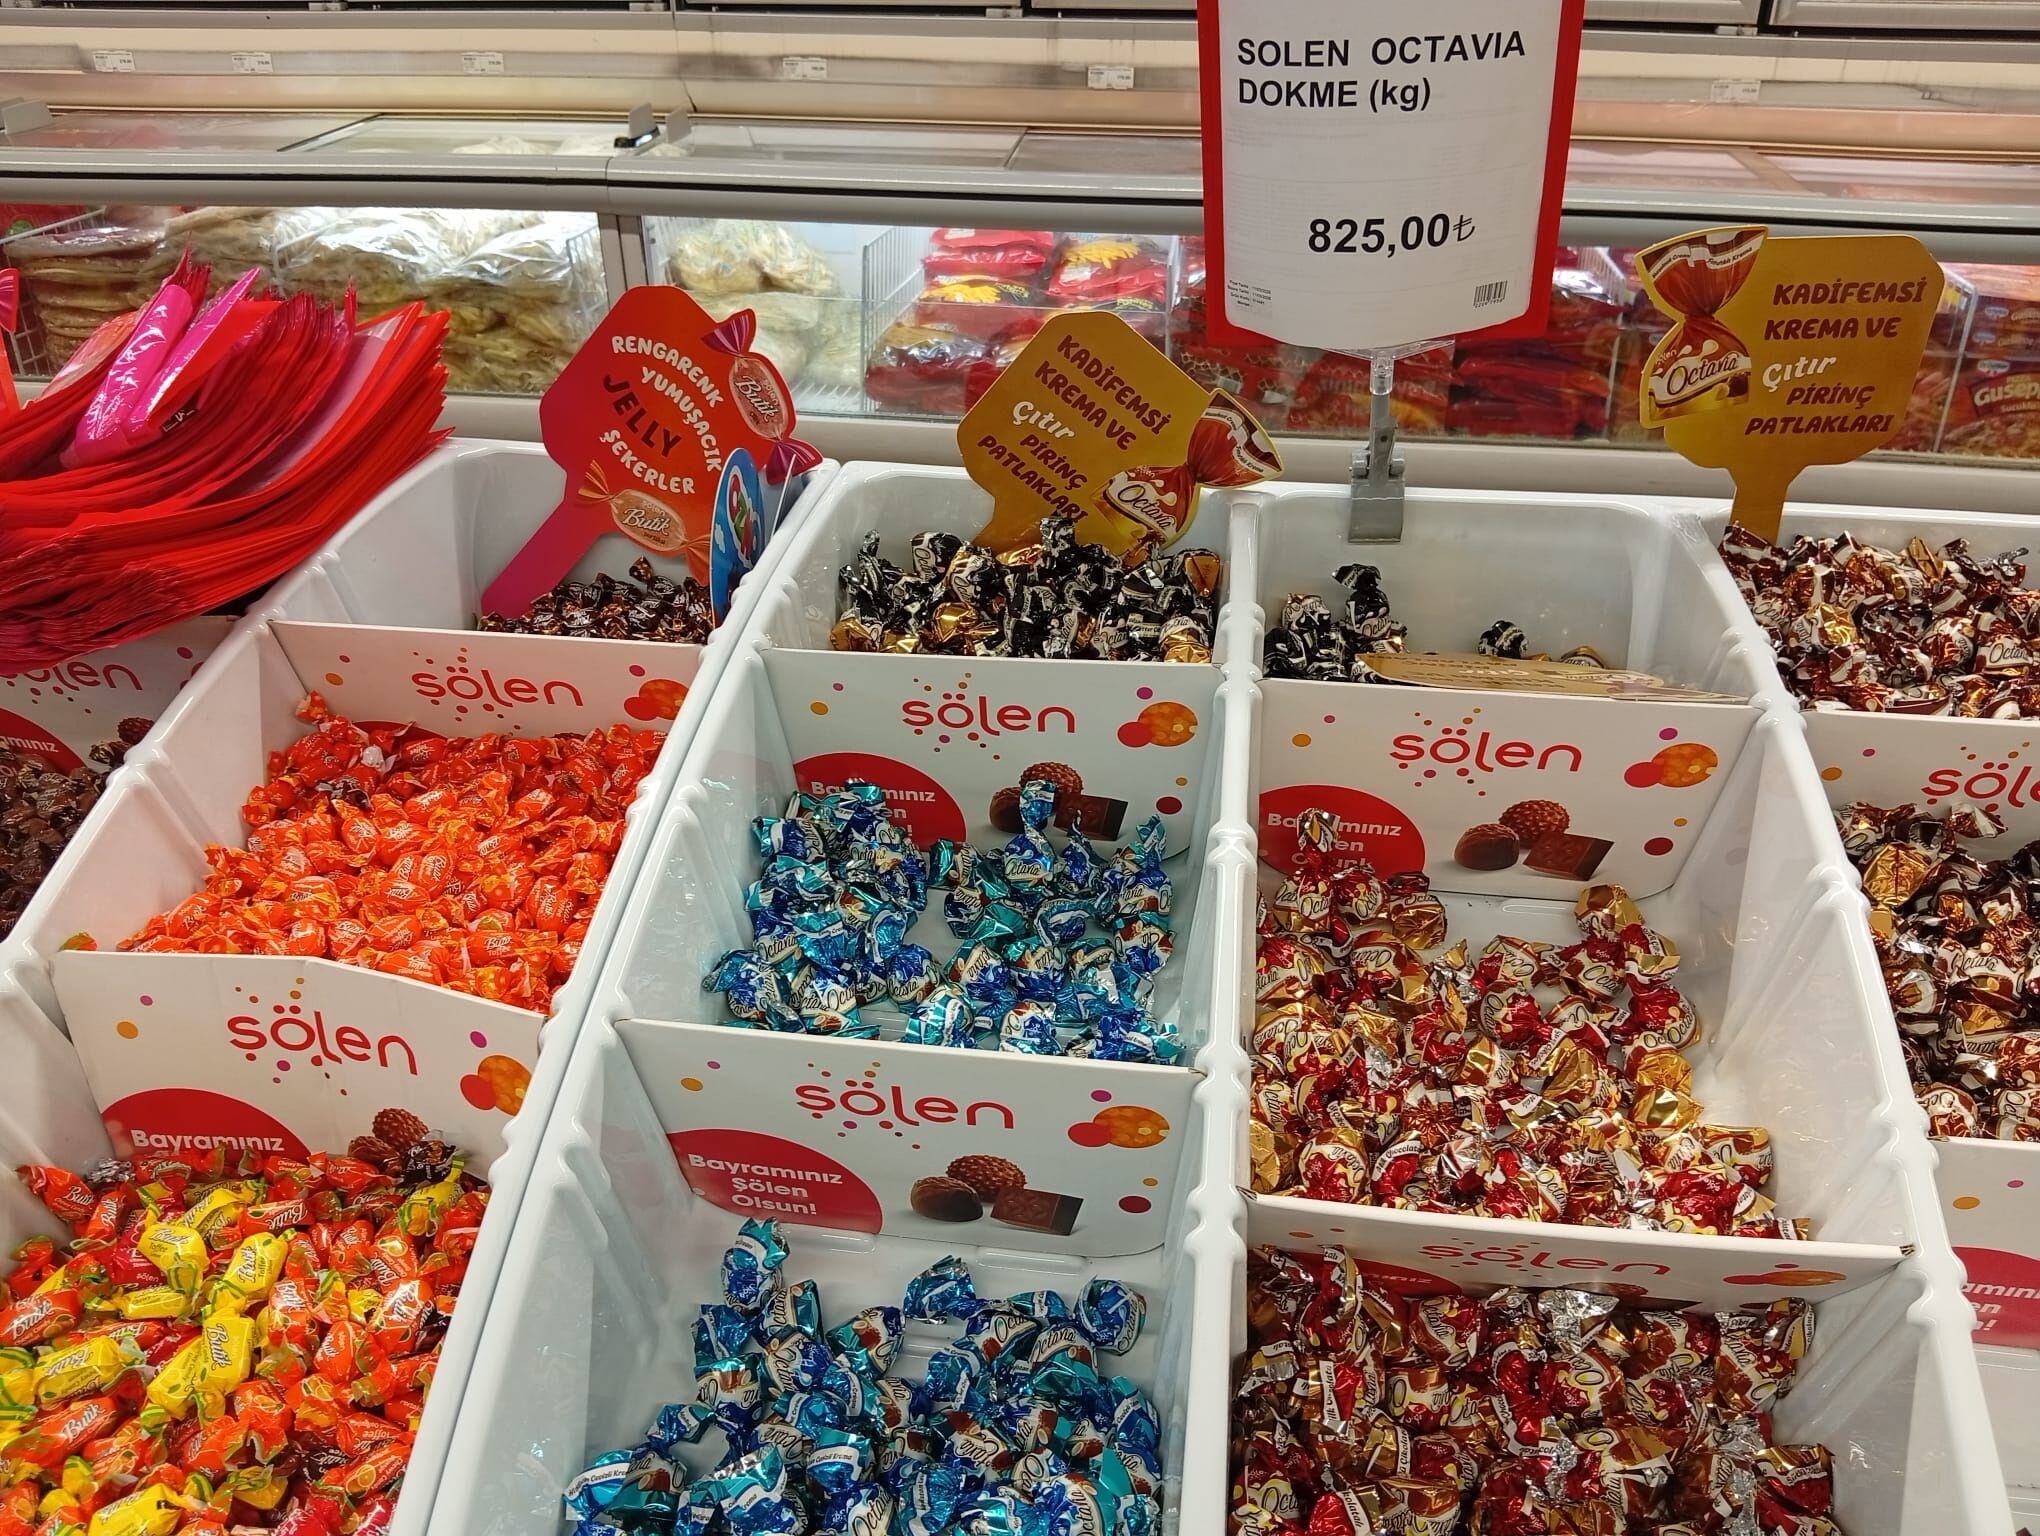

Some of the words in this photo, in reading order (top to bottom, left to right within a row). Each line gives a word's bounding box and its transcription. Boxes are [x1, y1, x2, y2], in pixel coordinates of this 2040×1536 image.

[1238, 38, 1349, 67] SOLEN
[1371, 31, 1526, 65] OCTAVIA
[1239, 79, 1358, 107] DOKME
[1370, 78, 1431, 112] (kg)
[1773, 276, 1927, 306] KADİFEMSİ
[1763, 318, 1859, 341] KREMA
[1865, 316, 1903, 338] VE
[612, 336, 725, 408] RENGARENK
[1056, 334, 1173, 435] KADİFEMSİ
[1666, 351, 1739, 397] Octavia
[1761, 354, 1838, 393] Çıtır
[603, 375, 682, 458] JELLY
[735, 375, 779, 422] Butik
[1034, 360, 1107, 429] KREMA
[1105, 418, 1137, 451] VE
[1786, 383, 1876, 410] PİRİNÇ
[641, 367, 722, 472] YUMUŞACIK
[1012, 400, 1077, 440] Çıtır
[1744, 414, 1895, 436] PATLAKLARI
[600, 430, 695, 495] ŞEKERLER
[977, 434, 1088, 525] PATLAKLARI
[1020, 434, 1088, 491] PİRİNÇ
[622, 508, 670, 536] Butik
[1117, 484, 1172, 530] Octavia
[689, 1153, 844, 1186] Bayramınız
[731, 1176, 809, 1199] Şölen
[731, 1193, 817, 1215] Olsun!
[207, 1323, 233, 1371] Butik
[62, 1402, 107, 1442] Butik
